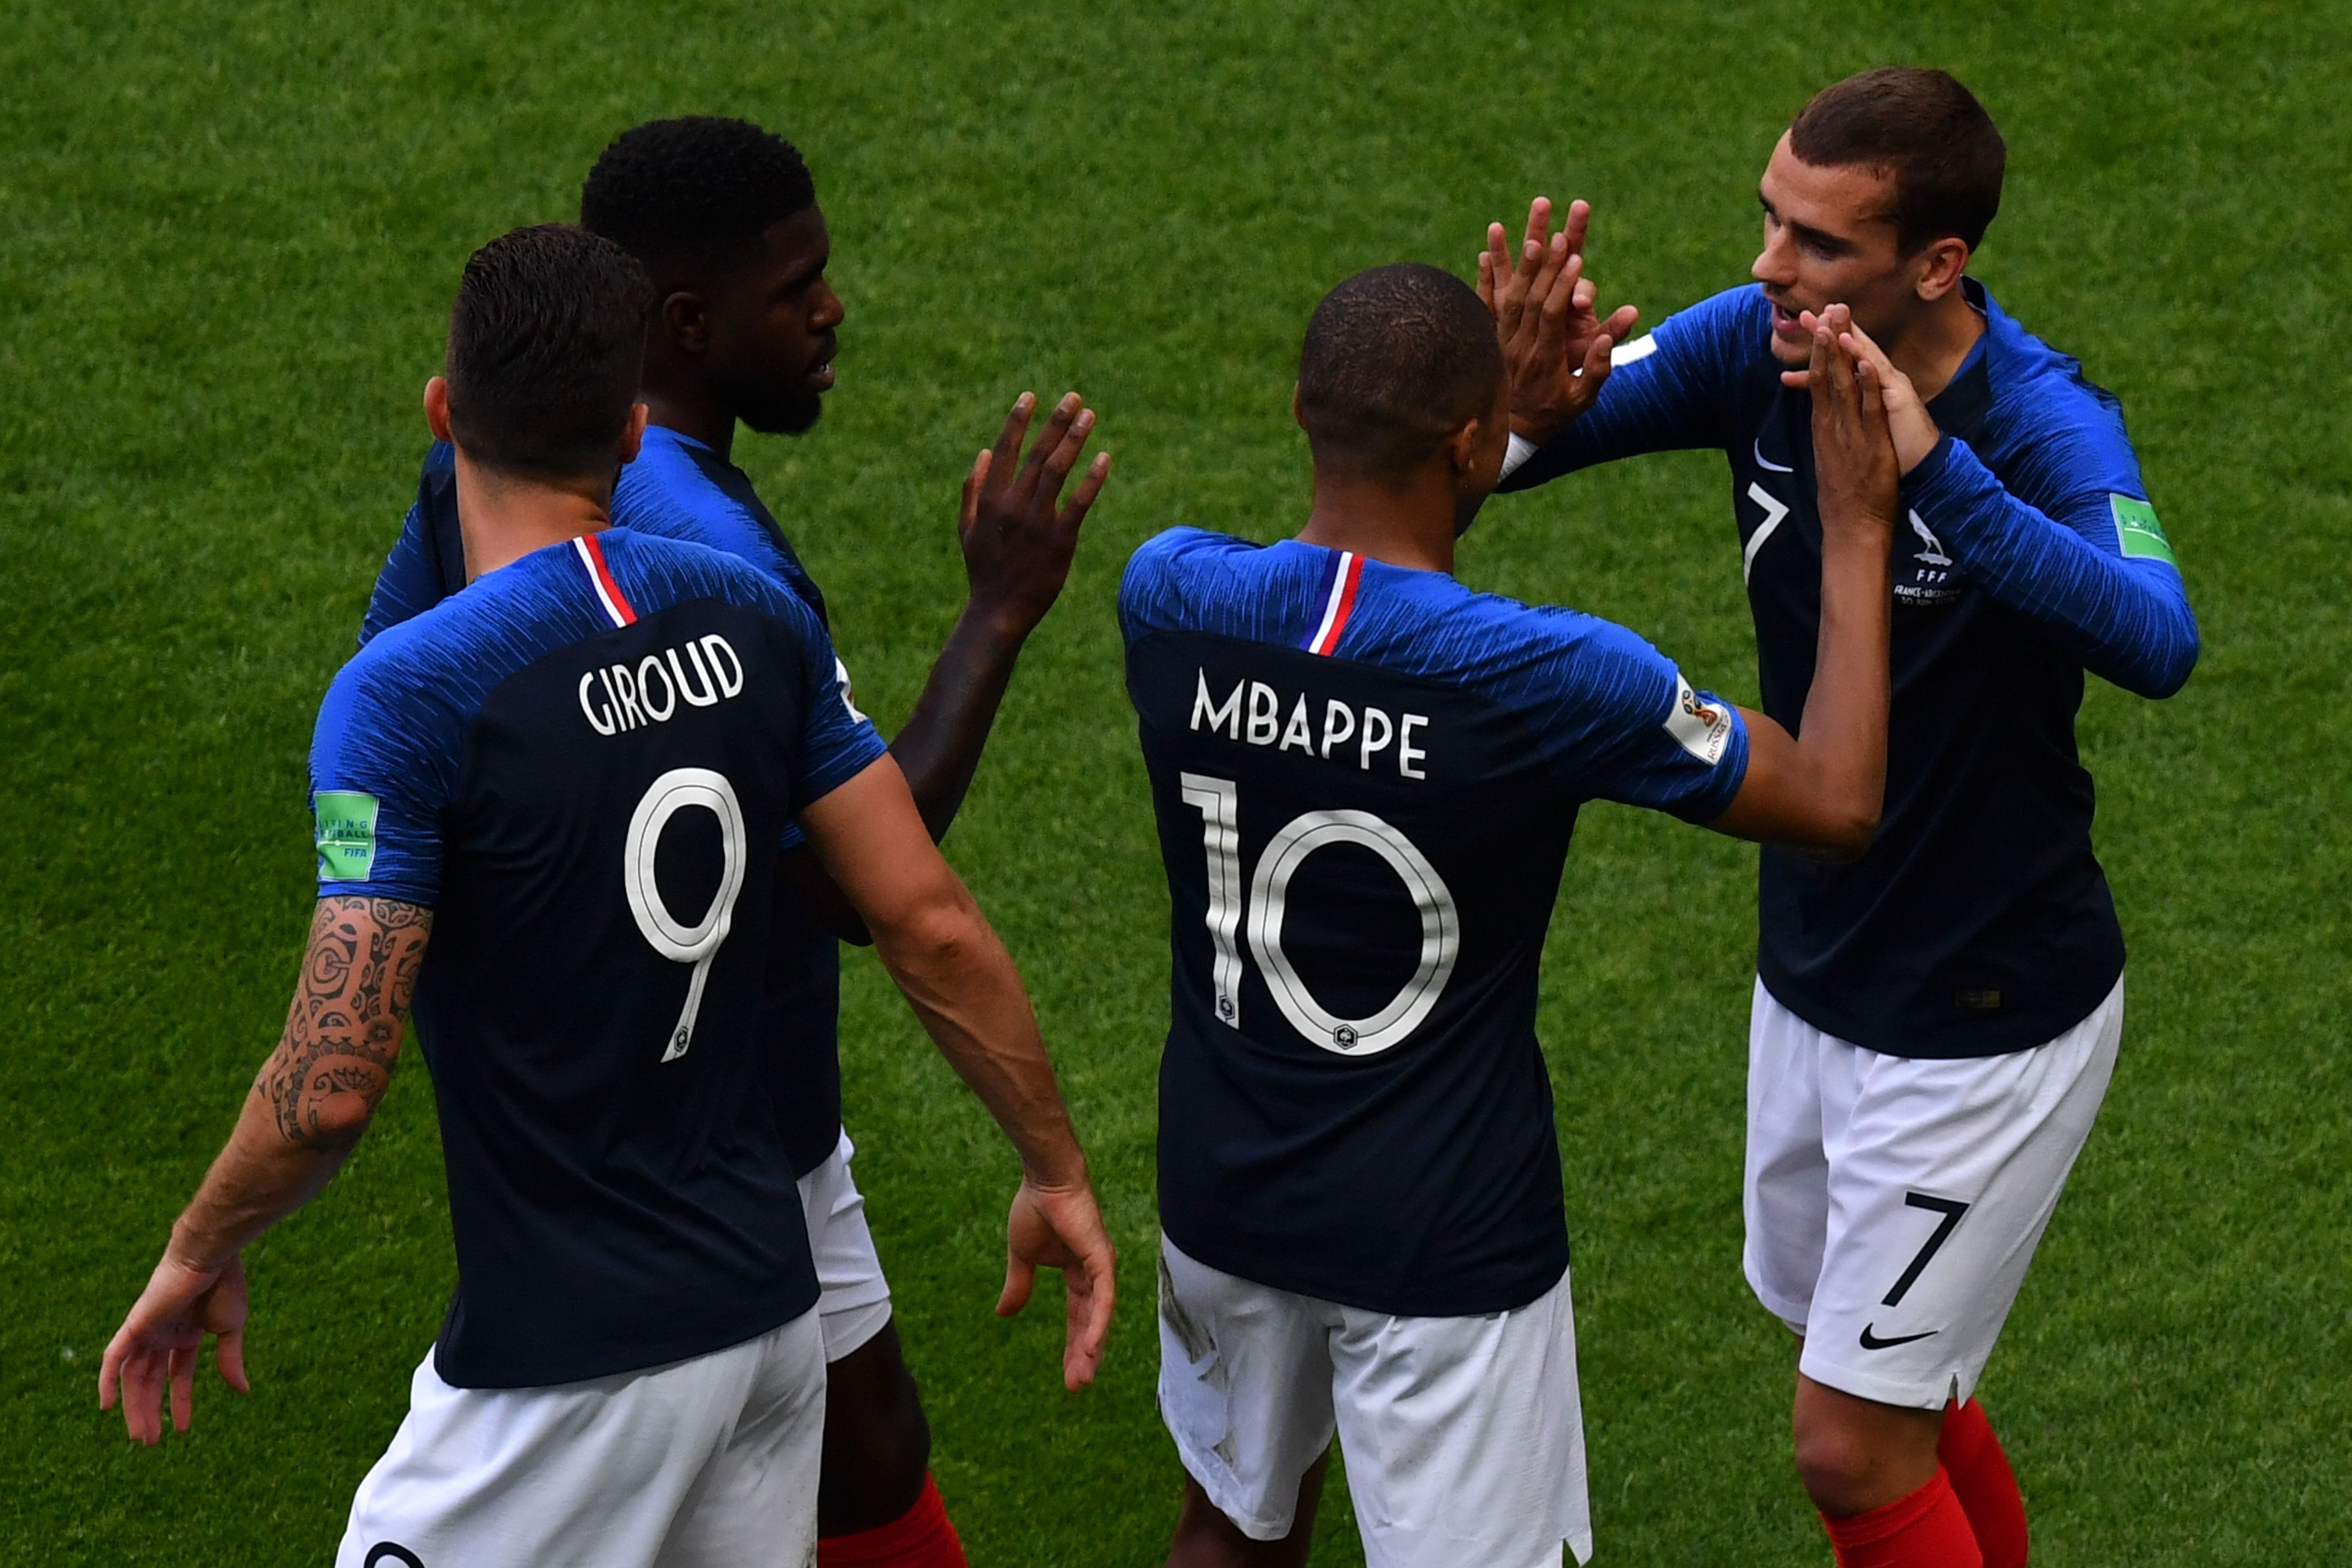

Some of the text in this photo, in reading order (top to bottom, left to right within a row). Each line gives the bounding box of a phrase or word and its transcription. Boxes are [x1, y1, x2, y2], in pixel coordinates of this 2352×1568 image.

[1744, 481, 1790, 588] 7
[579, 634, 744, 736] GIROUD
[1190, 666, 1429, 780] MBAPPE
[344, 848, 367, 857] FIFA
[624, 767, 746, 1063] 9
[1180, 771, 1460, 1055] 10
[1881, 1191, 1971, 1307] 7
